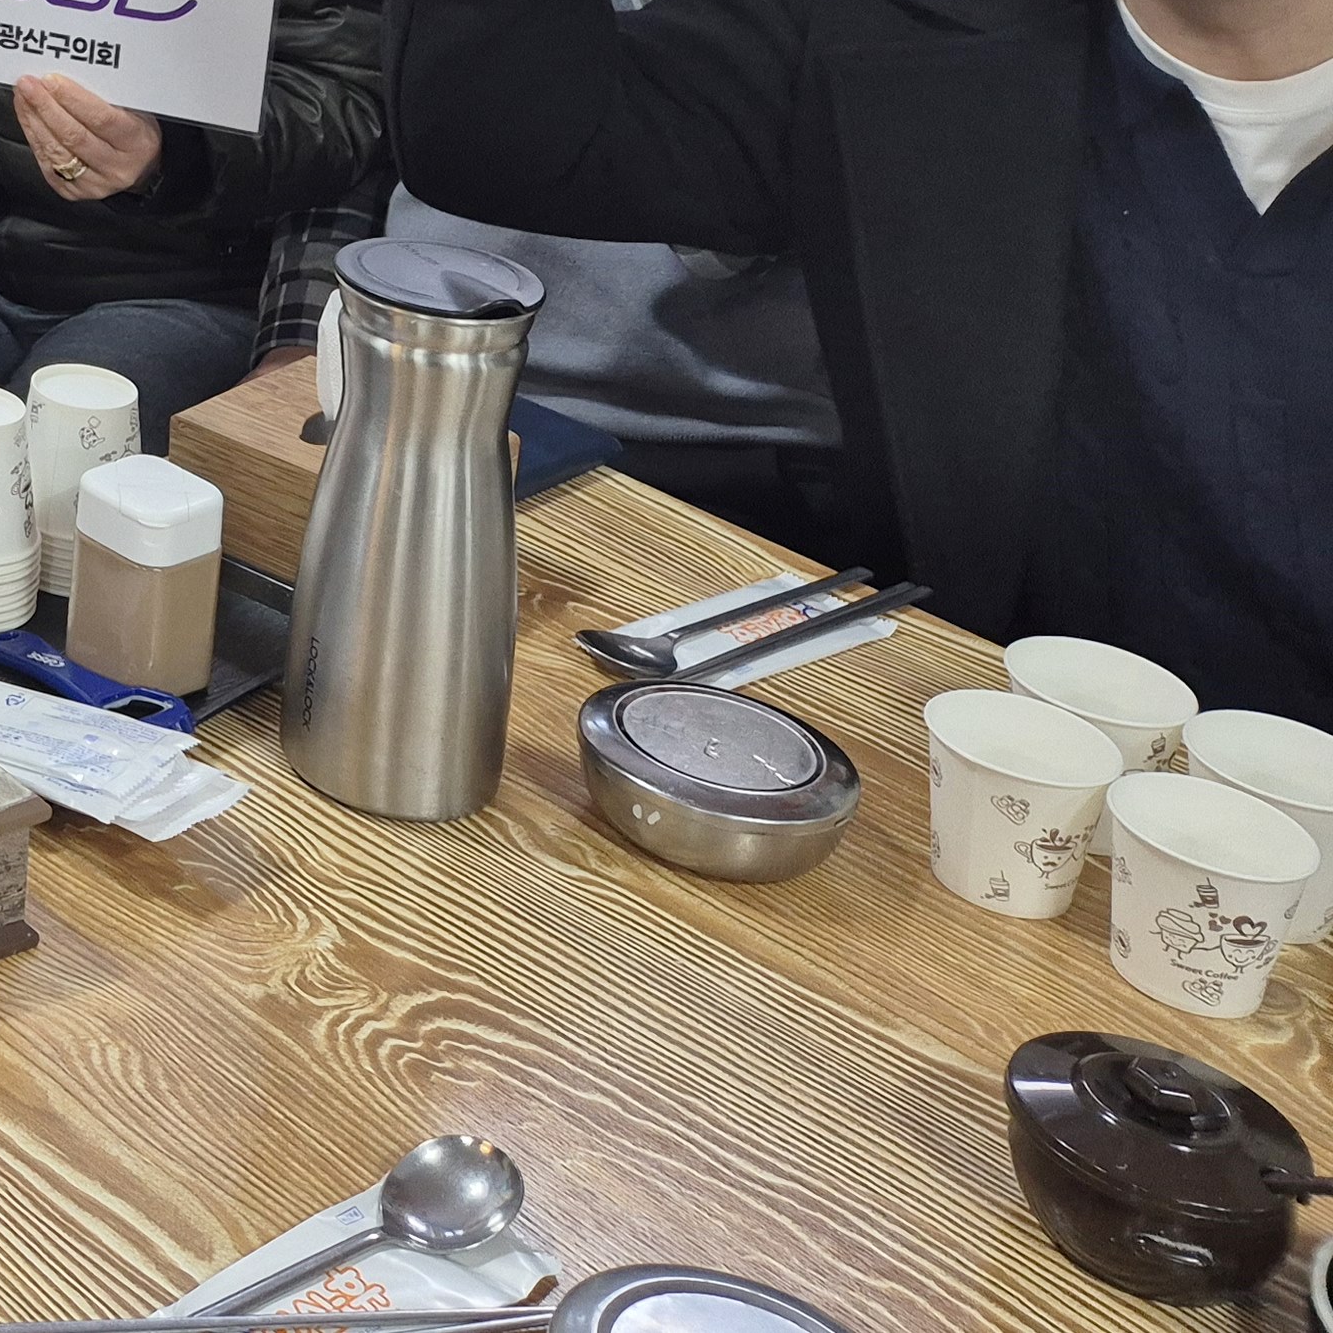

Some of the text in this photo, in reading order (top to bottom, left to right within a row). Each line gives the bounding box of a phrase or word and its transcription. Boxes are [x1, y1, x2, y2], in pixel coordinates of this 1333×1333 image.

[302, 636, 320, 732] LOCK&LOCK
[1170, 958, 1240, 982] Sweet Coffee
